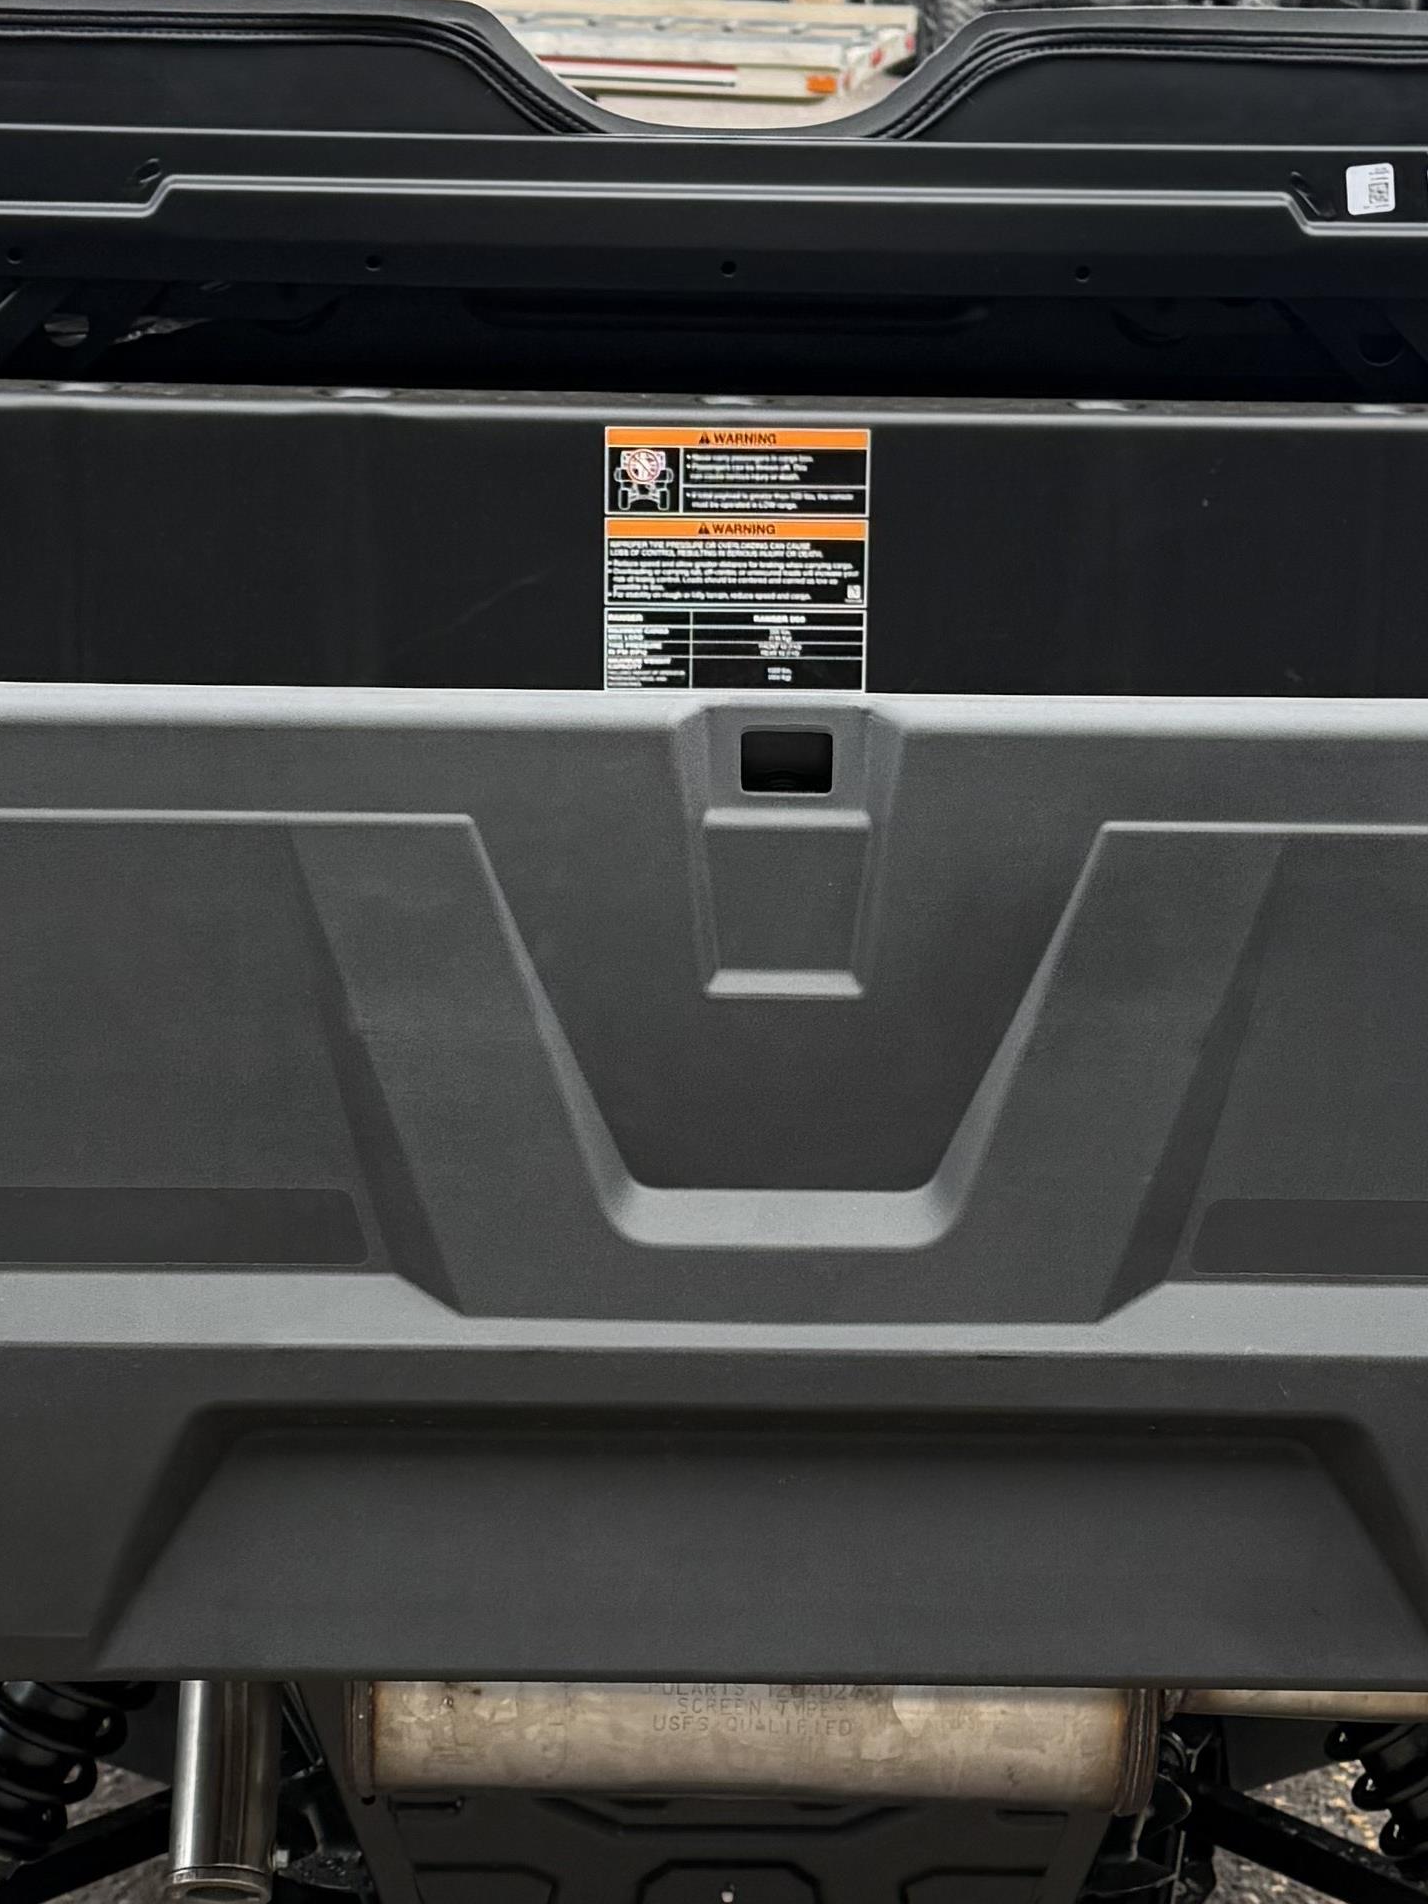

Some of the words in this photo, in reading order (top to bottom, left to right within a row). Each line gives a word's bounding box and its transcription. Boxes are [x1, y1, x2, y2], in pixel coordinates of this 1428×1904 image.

[713, 432, 777, 444] WARNING
[712, 523, 776, 535] WARNING
[677, 1697, 761, 1715] SCREEN
[653, 1715, 709, 1732] USFS
[726, 1717, 853, 1736] QUALIFIED
